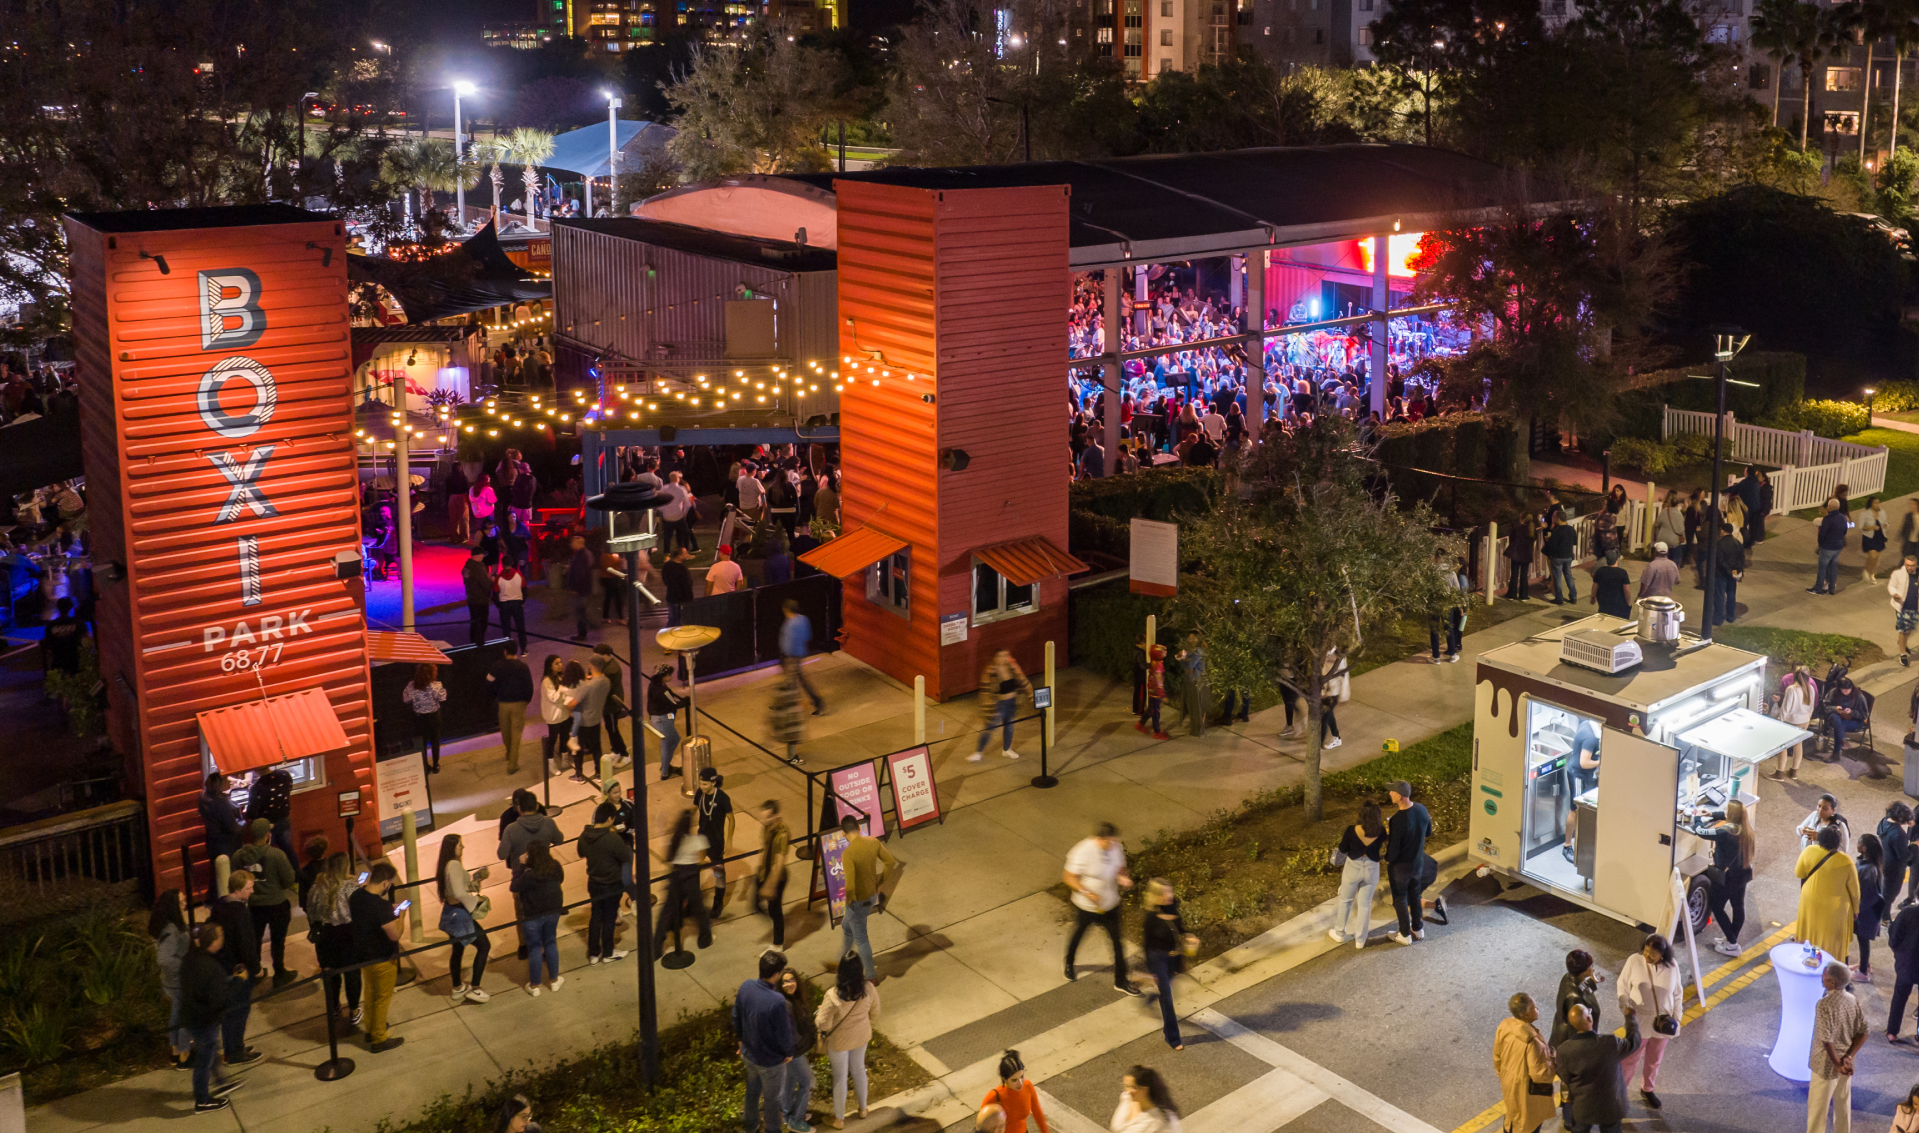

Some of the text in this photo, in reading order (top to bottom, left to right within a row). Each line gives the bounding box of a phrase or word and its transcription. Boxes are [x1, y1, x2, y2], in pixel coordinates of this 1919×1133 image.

[197, 267, 280, 607] BOXI
[1035, 694, 1049, 702] EXIT
[848, 772, 859, 780] NO
[902, 764, 916, 778] $5
[839, 777, 871, 791] OUTSIDE
[902, 781, 926, 793] COVER
[902, 788, 929, 802] CHARGE
